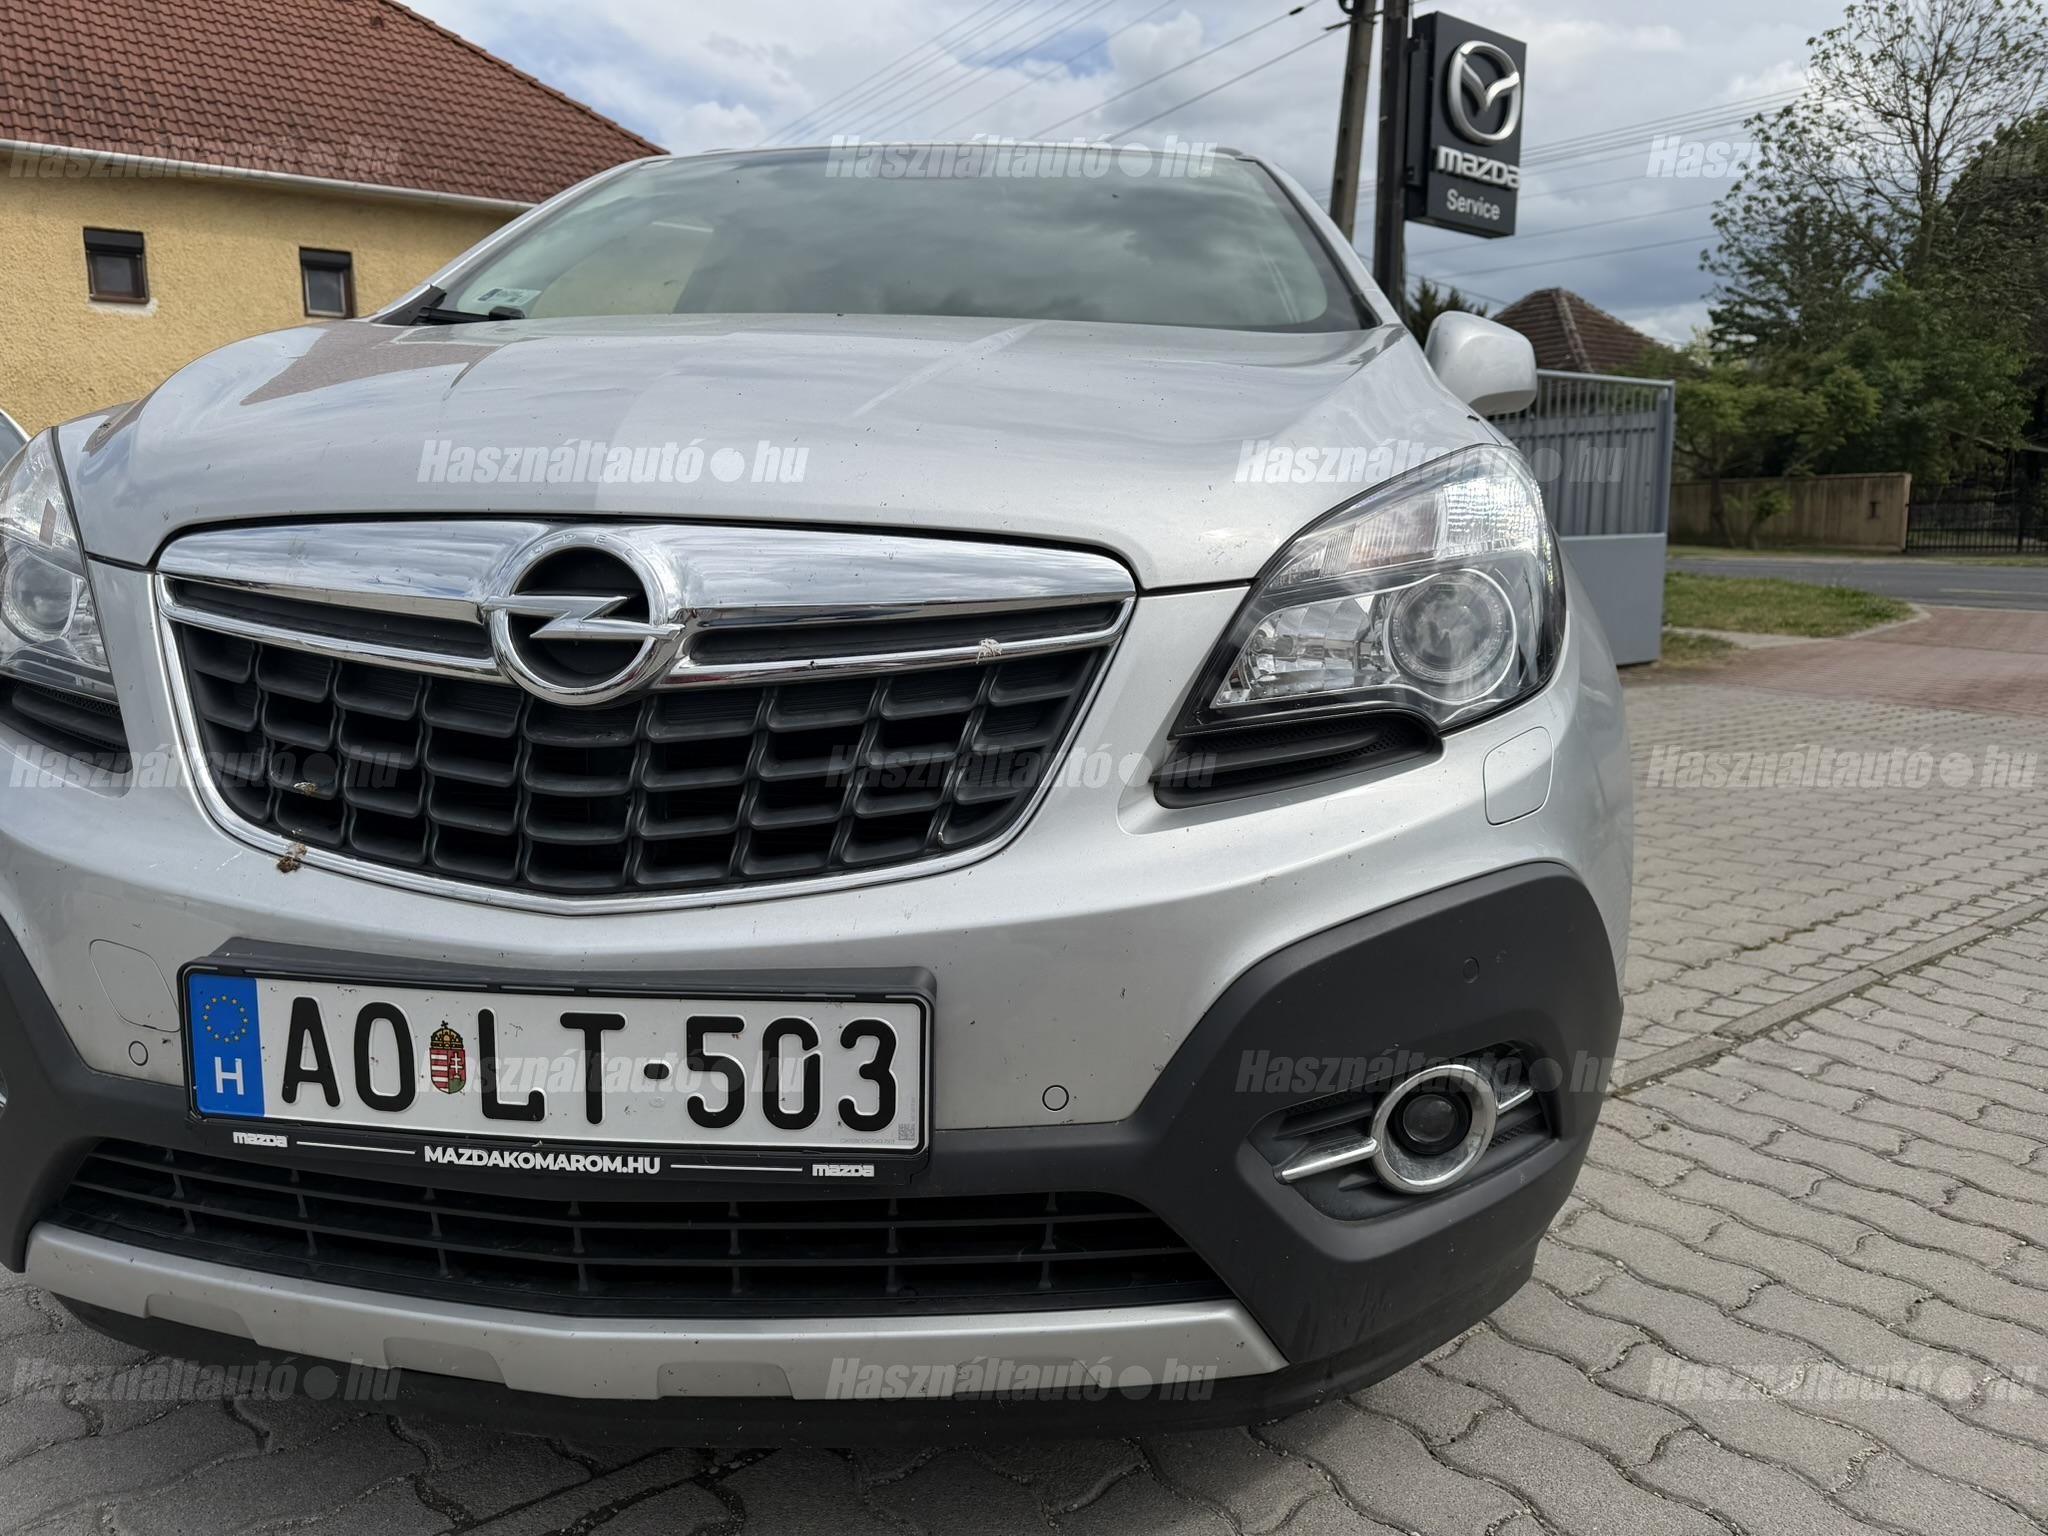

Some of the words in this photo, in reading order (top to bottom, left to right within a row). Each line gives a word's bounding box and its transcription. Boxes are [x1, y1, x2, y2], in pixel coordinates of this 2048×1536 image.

[1446, 188, 1501, 220] Service
[281, 996, 417, 1113] AO
[214, 1056, 245, 1096] H
[424, 1145, 661, 1175] MAZDAKOMAROM.HU
